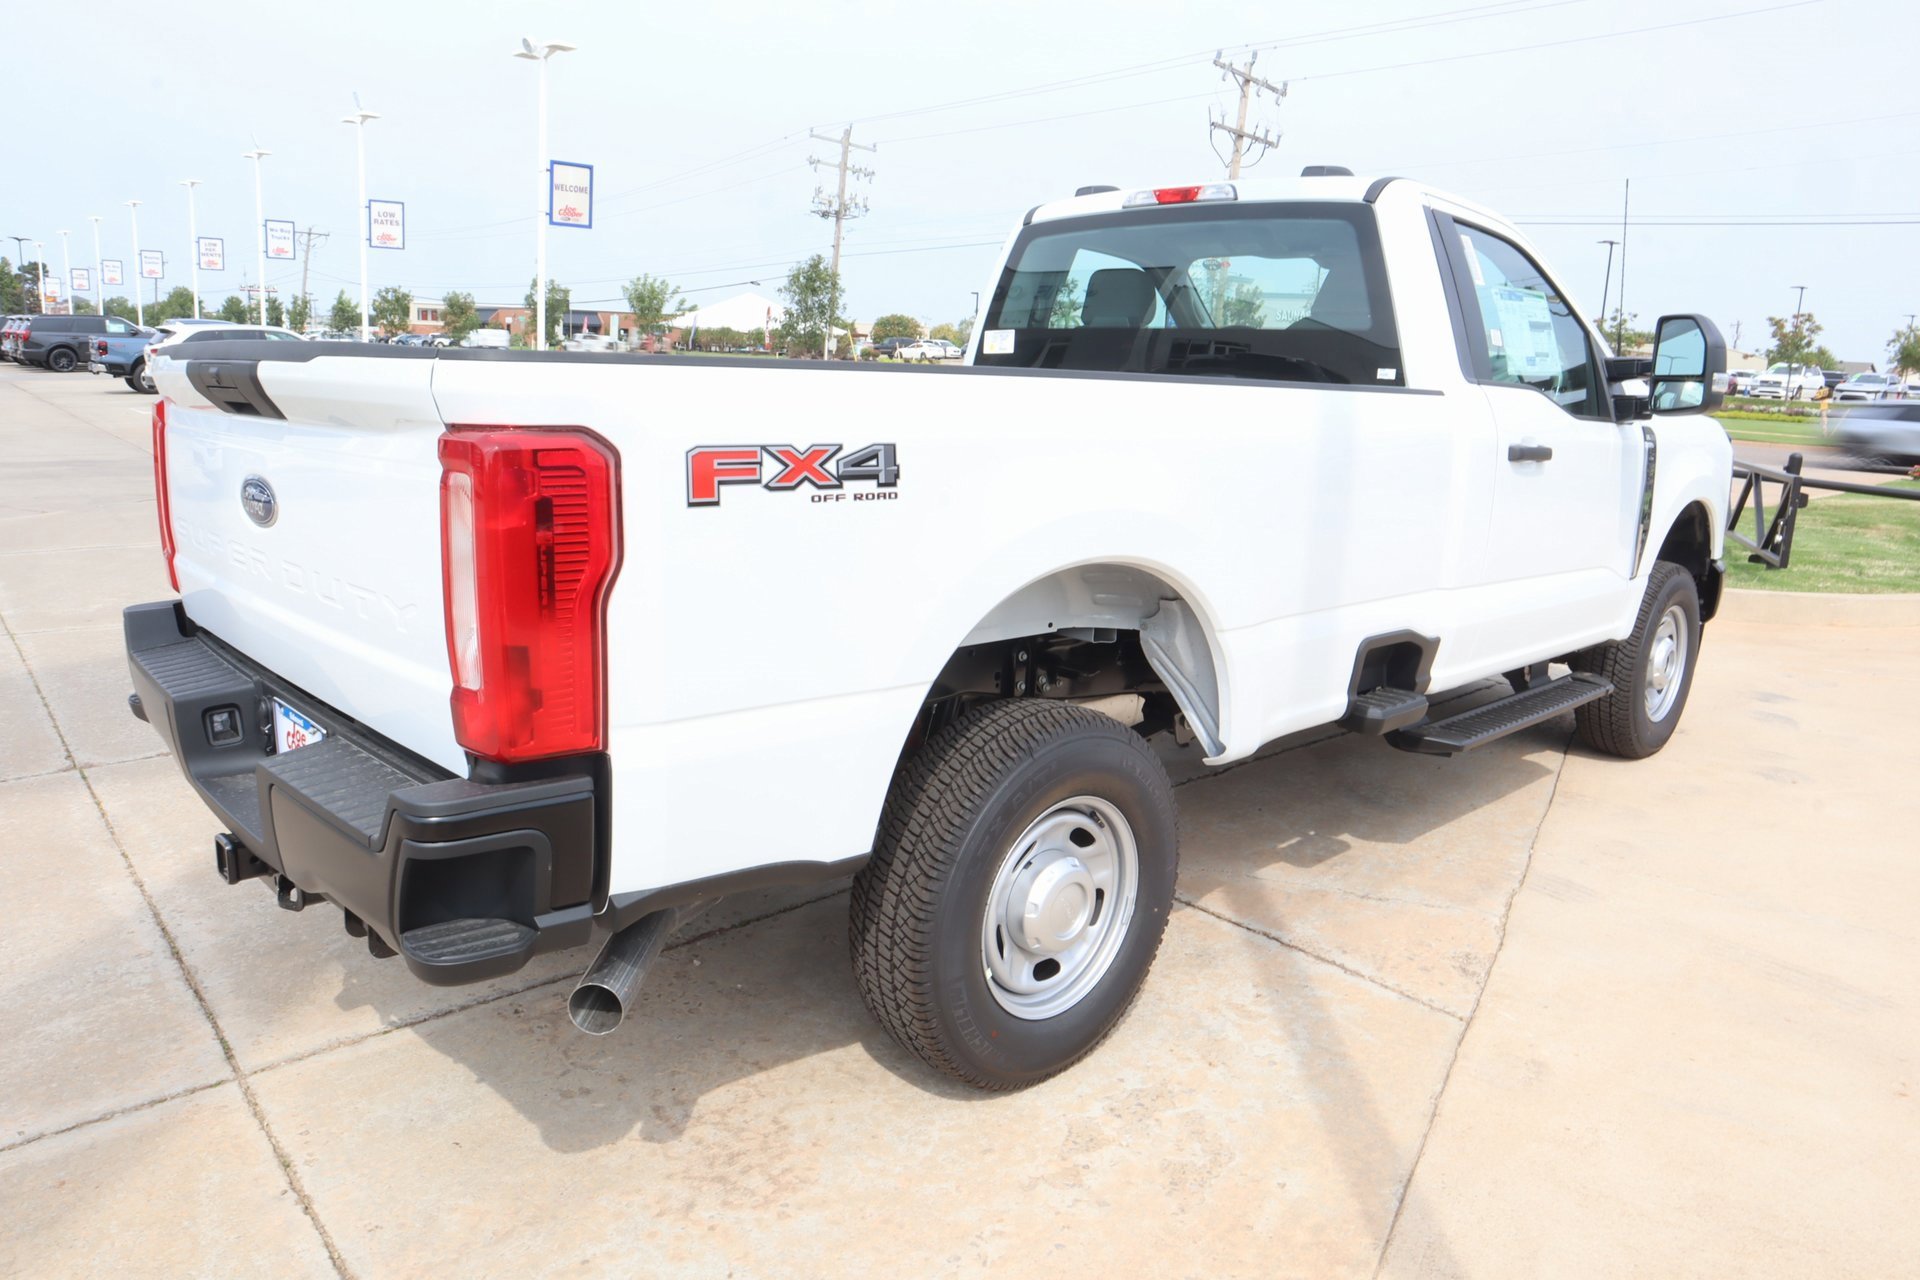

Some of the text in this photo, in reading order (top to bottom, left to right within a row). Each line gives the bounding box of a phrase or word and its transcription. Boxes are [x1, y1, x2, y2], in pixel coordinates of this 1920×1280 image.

[554, 184, 589, 194] WELCOME
[373, 218, 400, 226] RATES
[686, 443, 900, 508] FX4
[811, 492, 899, 503] OFF ROAD
[177, 518, 417, 634] SUPER DUTY
